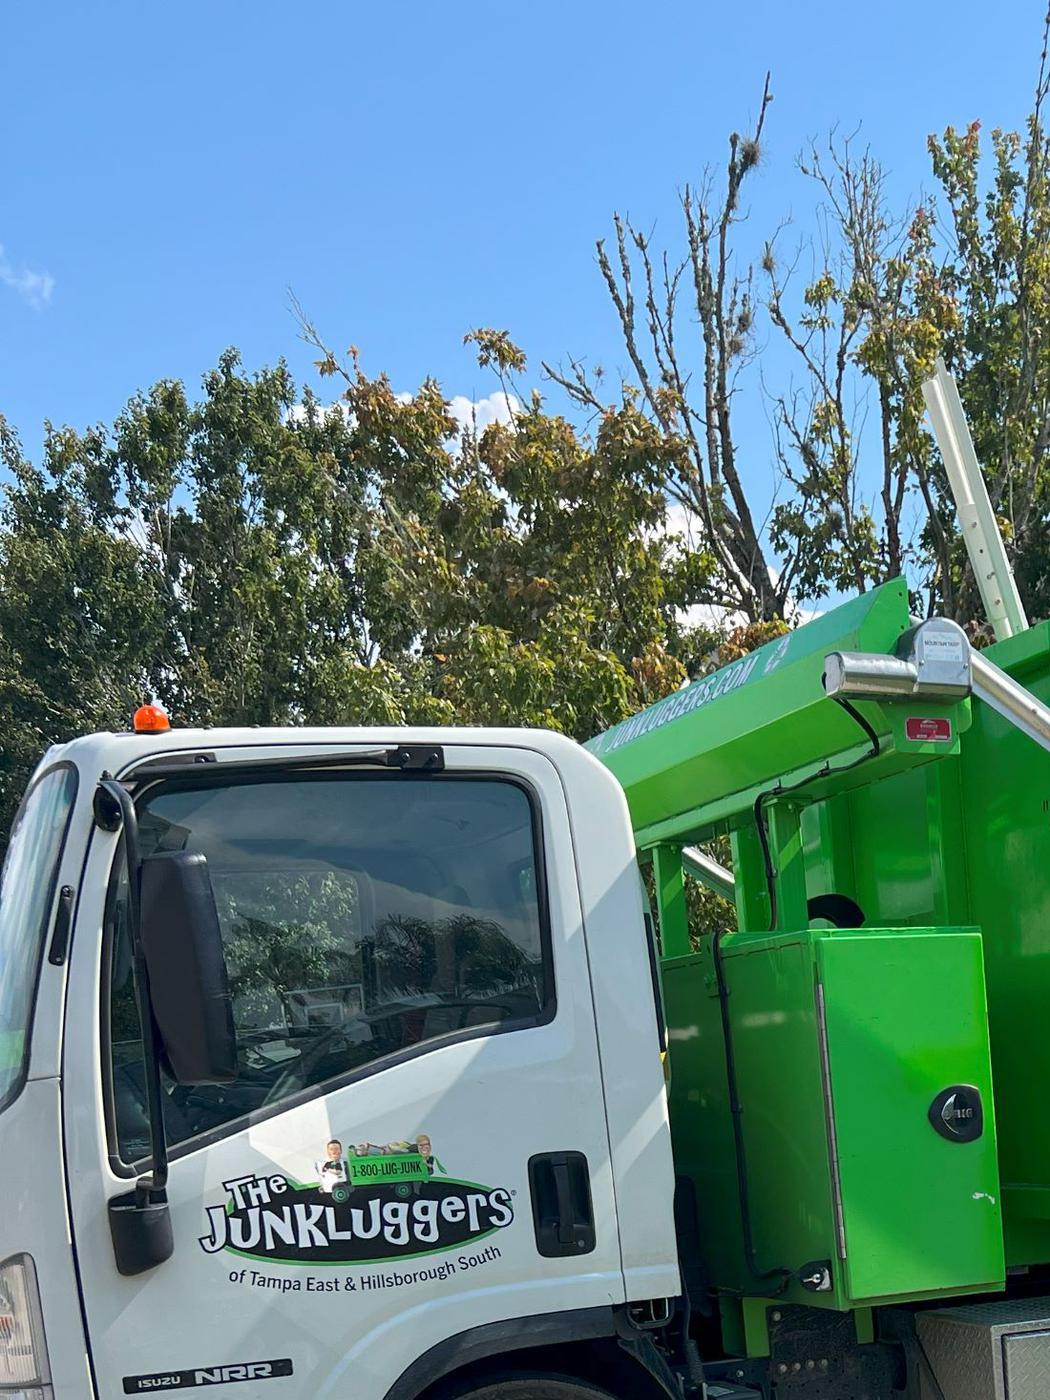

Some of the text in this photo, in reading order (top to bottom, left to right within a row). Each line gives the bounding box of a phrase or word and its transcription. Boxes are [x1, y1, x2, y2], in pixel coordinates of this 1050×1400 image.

[352, 1161, 422, 1177] 1-800-LUG-JUNK
[229, 1246, 502, 1293] of Tampa East & Hillsborough South
[138, 1376, 181, 1388] ISUZU
[195, 1363, 272, 1385] NRR
